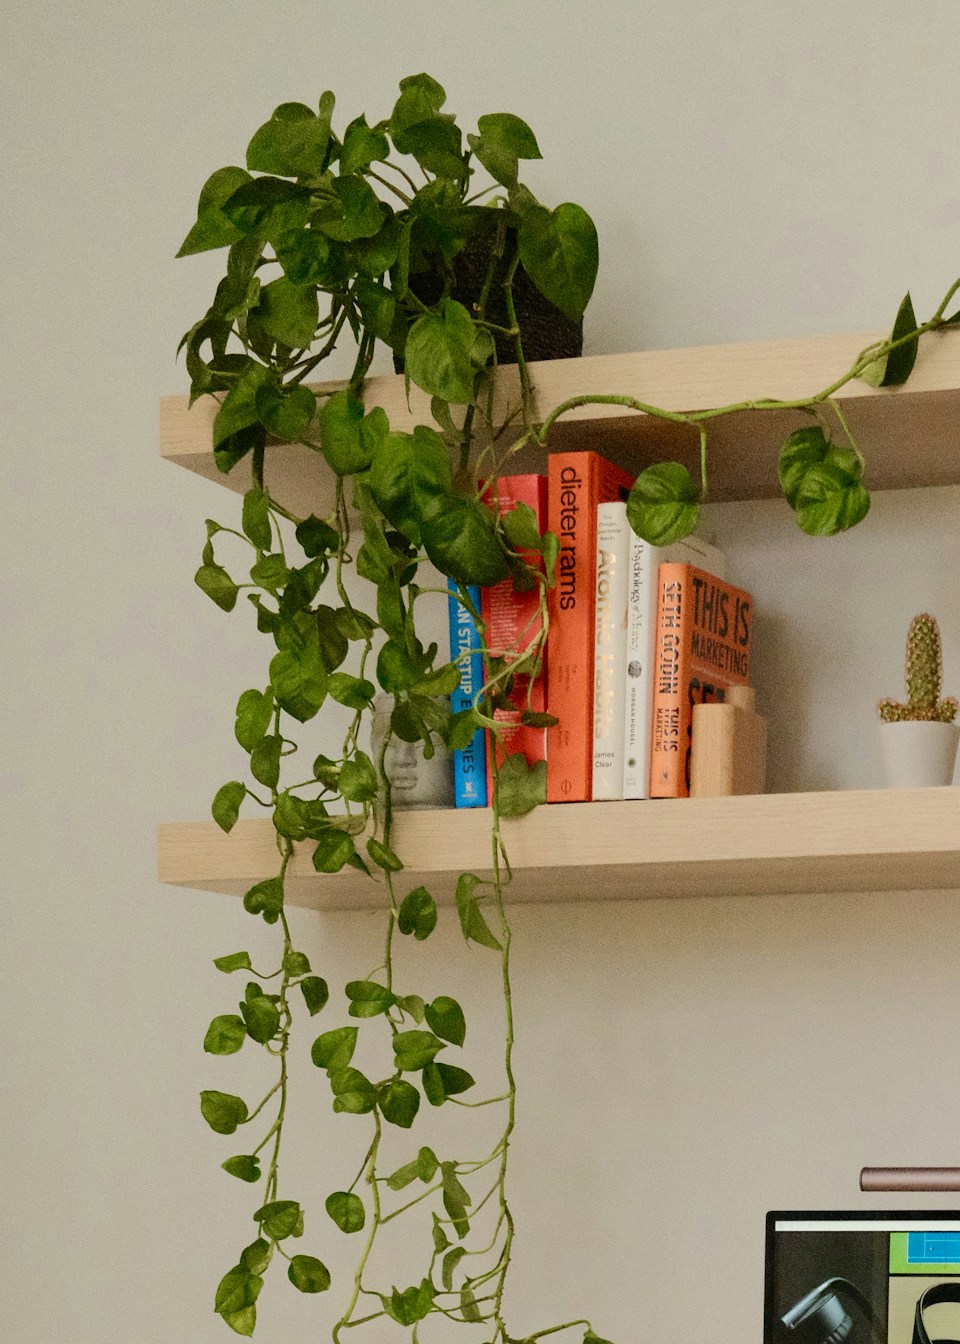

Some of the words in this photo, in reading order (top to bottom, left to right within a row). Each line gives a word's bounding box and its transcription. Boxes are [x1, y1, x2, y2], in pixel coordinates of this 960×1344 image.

[560, 466, 582, 536] dieter
[559, 546, 577, 611] rams
[630, 544, 644, 603] Psychology
[661, 581, 682, 627] SETH
[692, 577, 730, 638] THIS
[734, 597, 750, 647] IS
[458, 627, 473, 695] STARTUP
[659, 633, 680, 695] GODIN
[690, 630, 749, 678] MARKETING
[654, 707, 664, 752] MARKETING
[664, 706, 680, 737] THIS
[594, 752, 615, 760] James
[594, 760, 613, 769] Clear
[664, 740, 680, 752] IS
